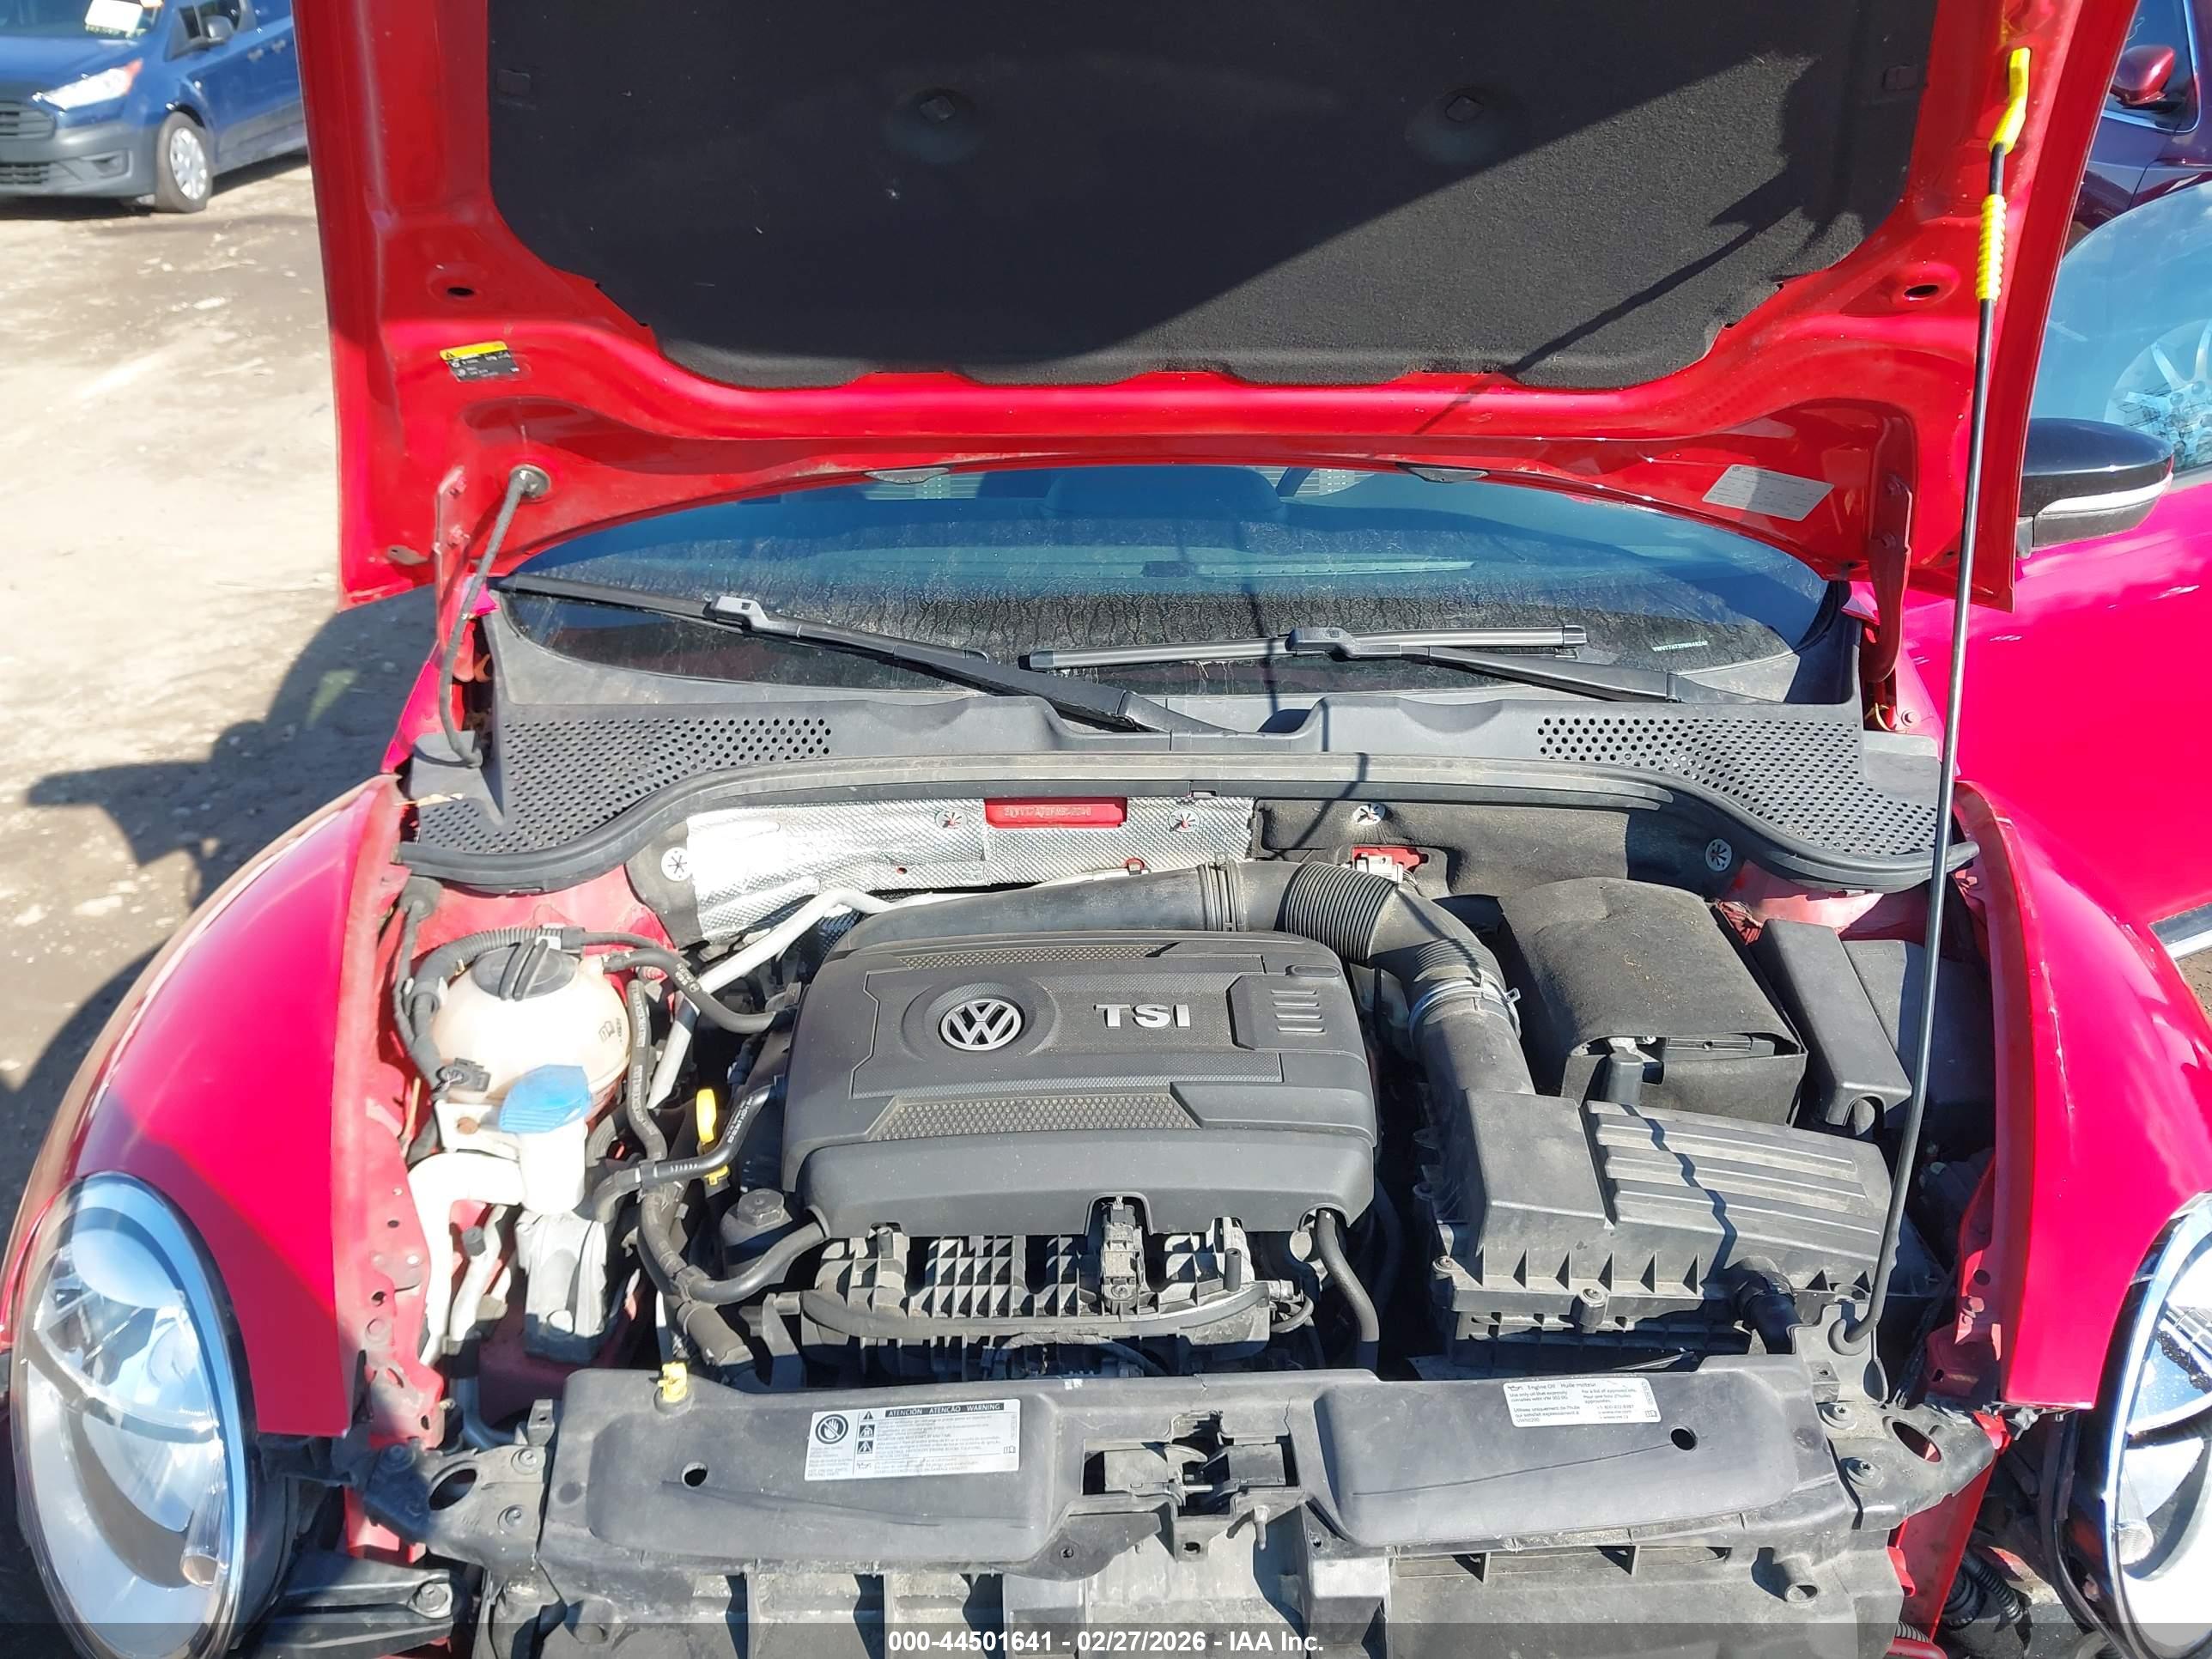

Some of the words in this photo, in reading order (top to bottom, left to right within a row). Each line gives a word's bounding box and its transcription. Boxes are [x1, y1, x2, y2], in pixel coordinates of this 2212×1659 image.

[1096, 1003, 1192, 1029] TSI
[889, 1407, 922, 1417] ATENCIÓN
[929, 1405, 961, 1414] ATENÇÃO
[967, 1403, 1000, 1412] WARNING
